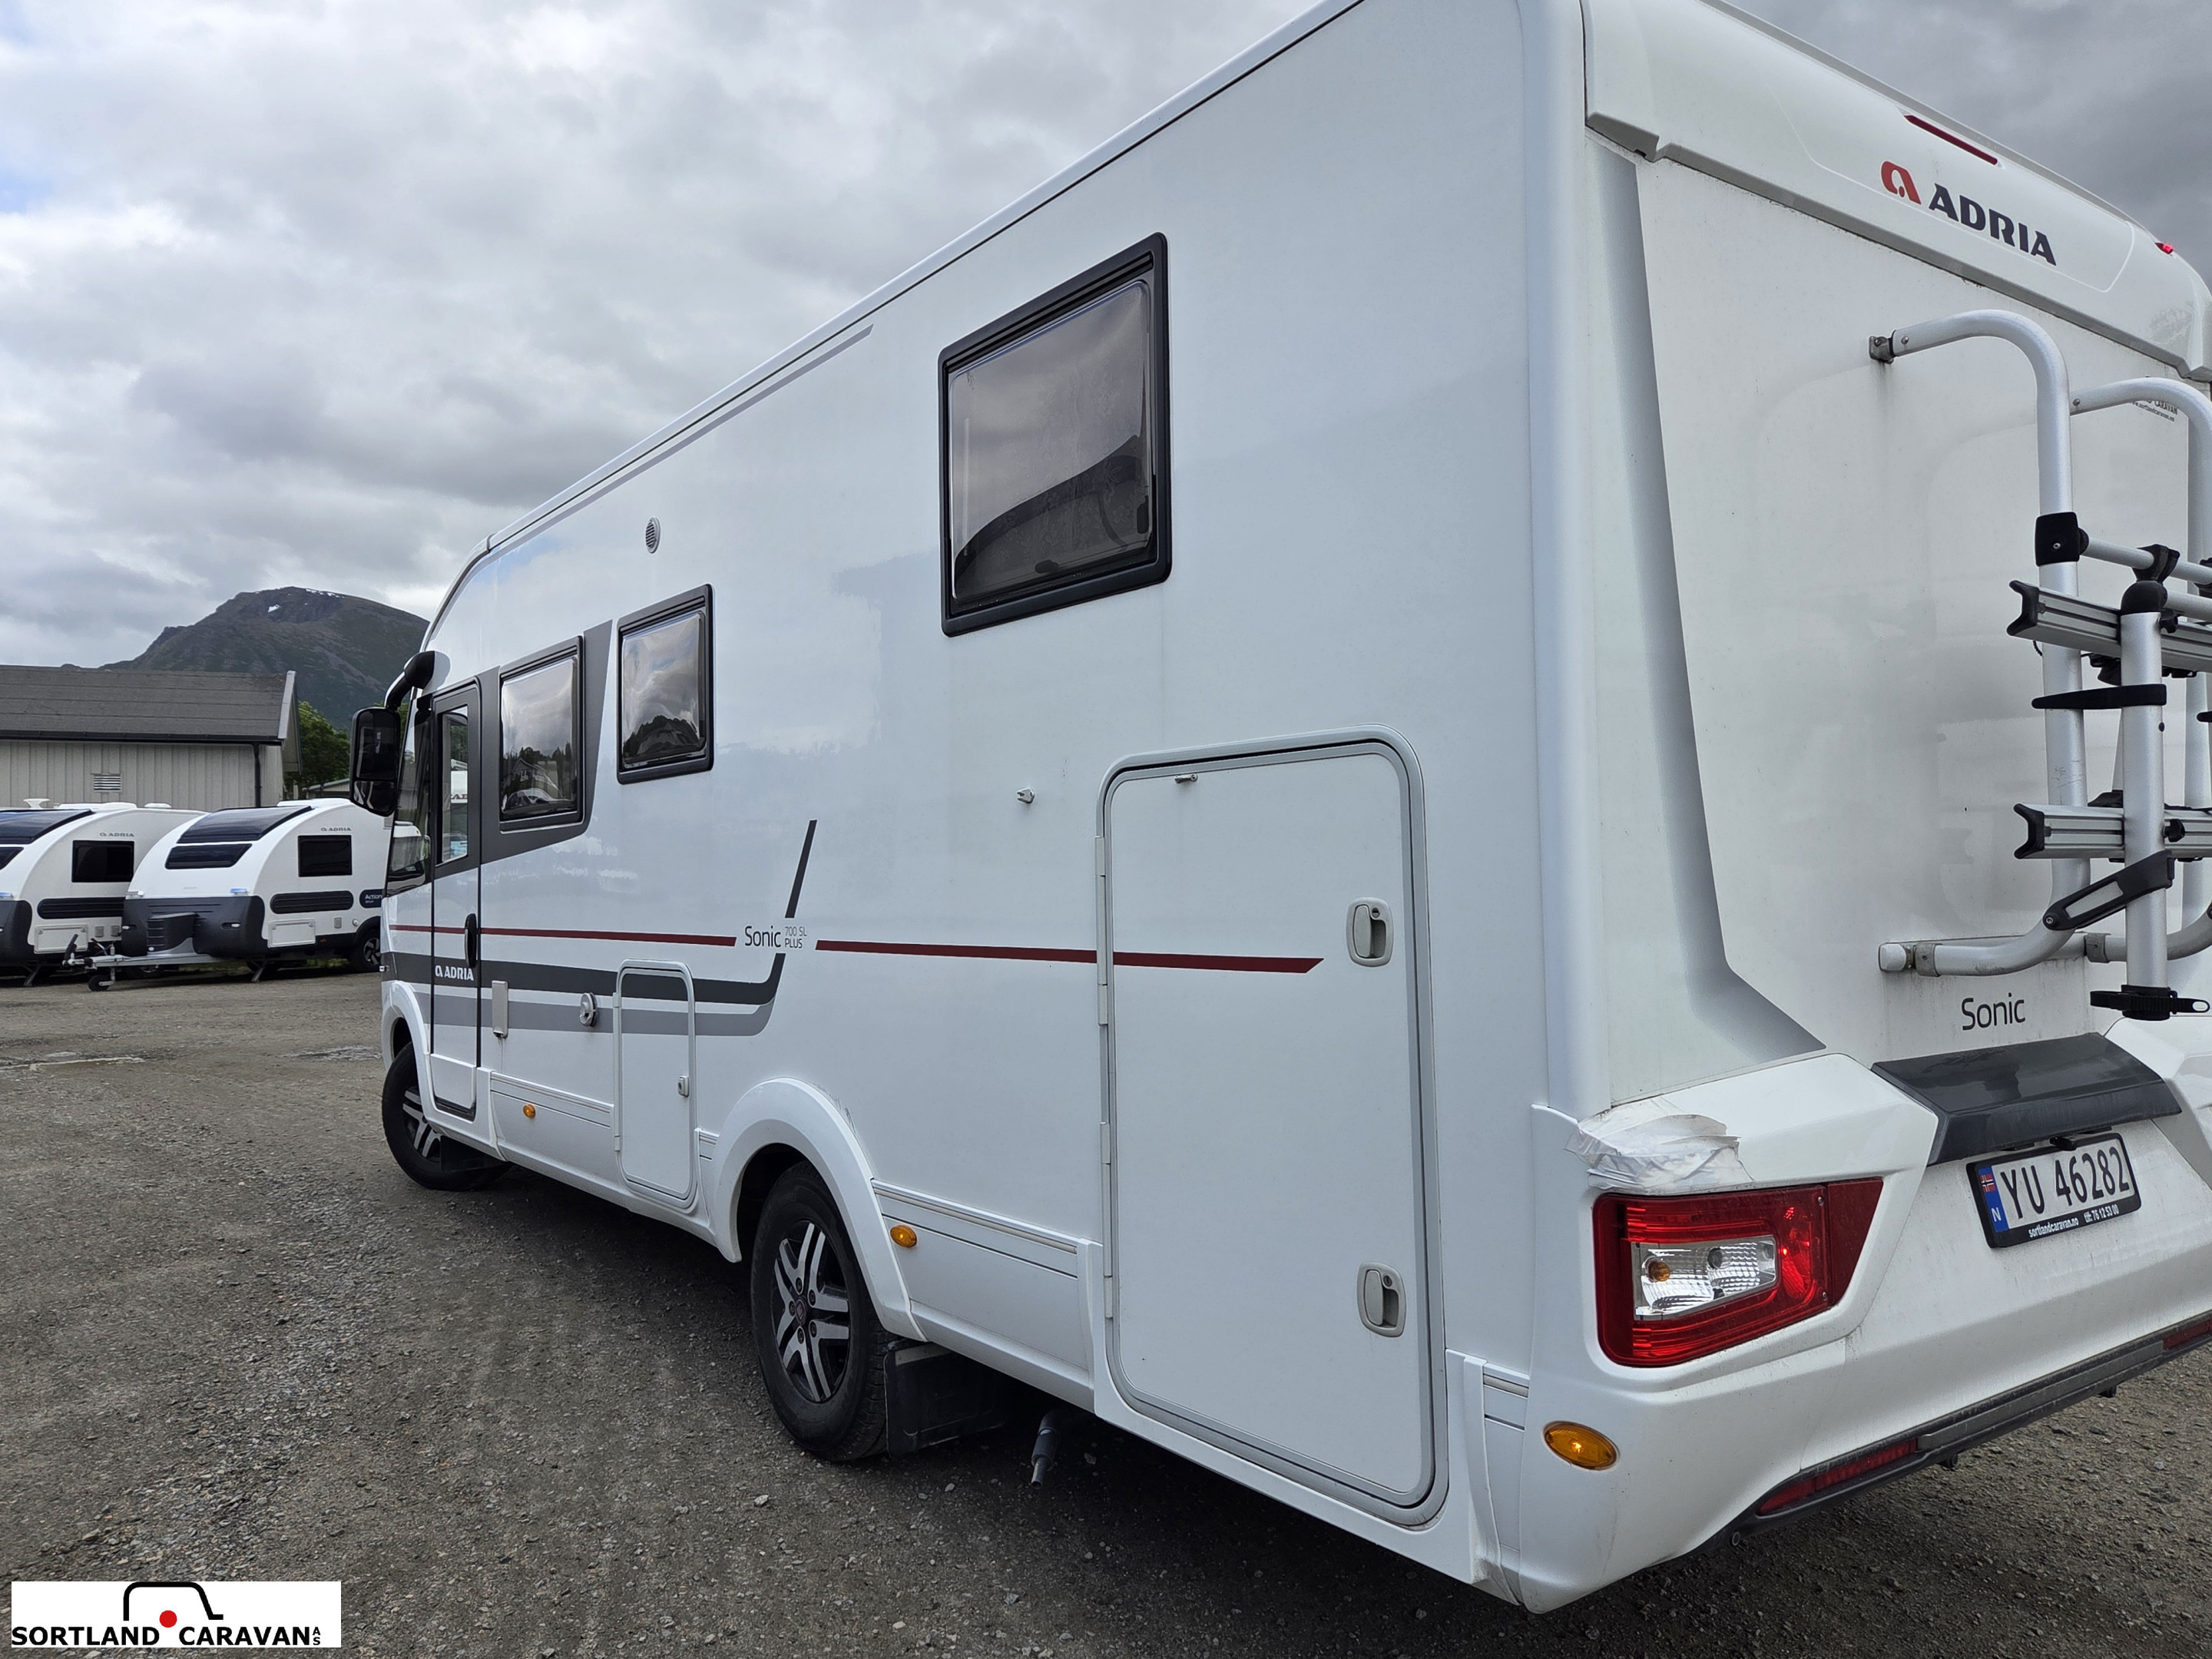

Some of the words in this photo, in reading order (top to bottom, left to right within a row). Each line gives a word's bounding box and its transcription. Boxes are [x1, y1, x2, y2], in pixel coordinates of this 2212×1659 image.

[1929, 183, 2057, 267] ADRIA
[744, 925, 781, 948] Sonic
[785, 926, 797, 936] 700
[799, 926, 807, 936] SL
[785, 938, 803, 949] PLUS
[444, 965, 475, 981] ADRIA
[1961, 992, 2026, 1031] Sonic
[2000, 1165, 2045, 1220] YU
[2055, 1146, 2130, 1207] 46282
[1991, 1207, 2002, 1223] N
[2028, 1217, 2079, 1238] sortlandcaravan.no
[2091, 1209, 2100, 1221] 76
[2099, 1207, 2107, 1219] 12
